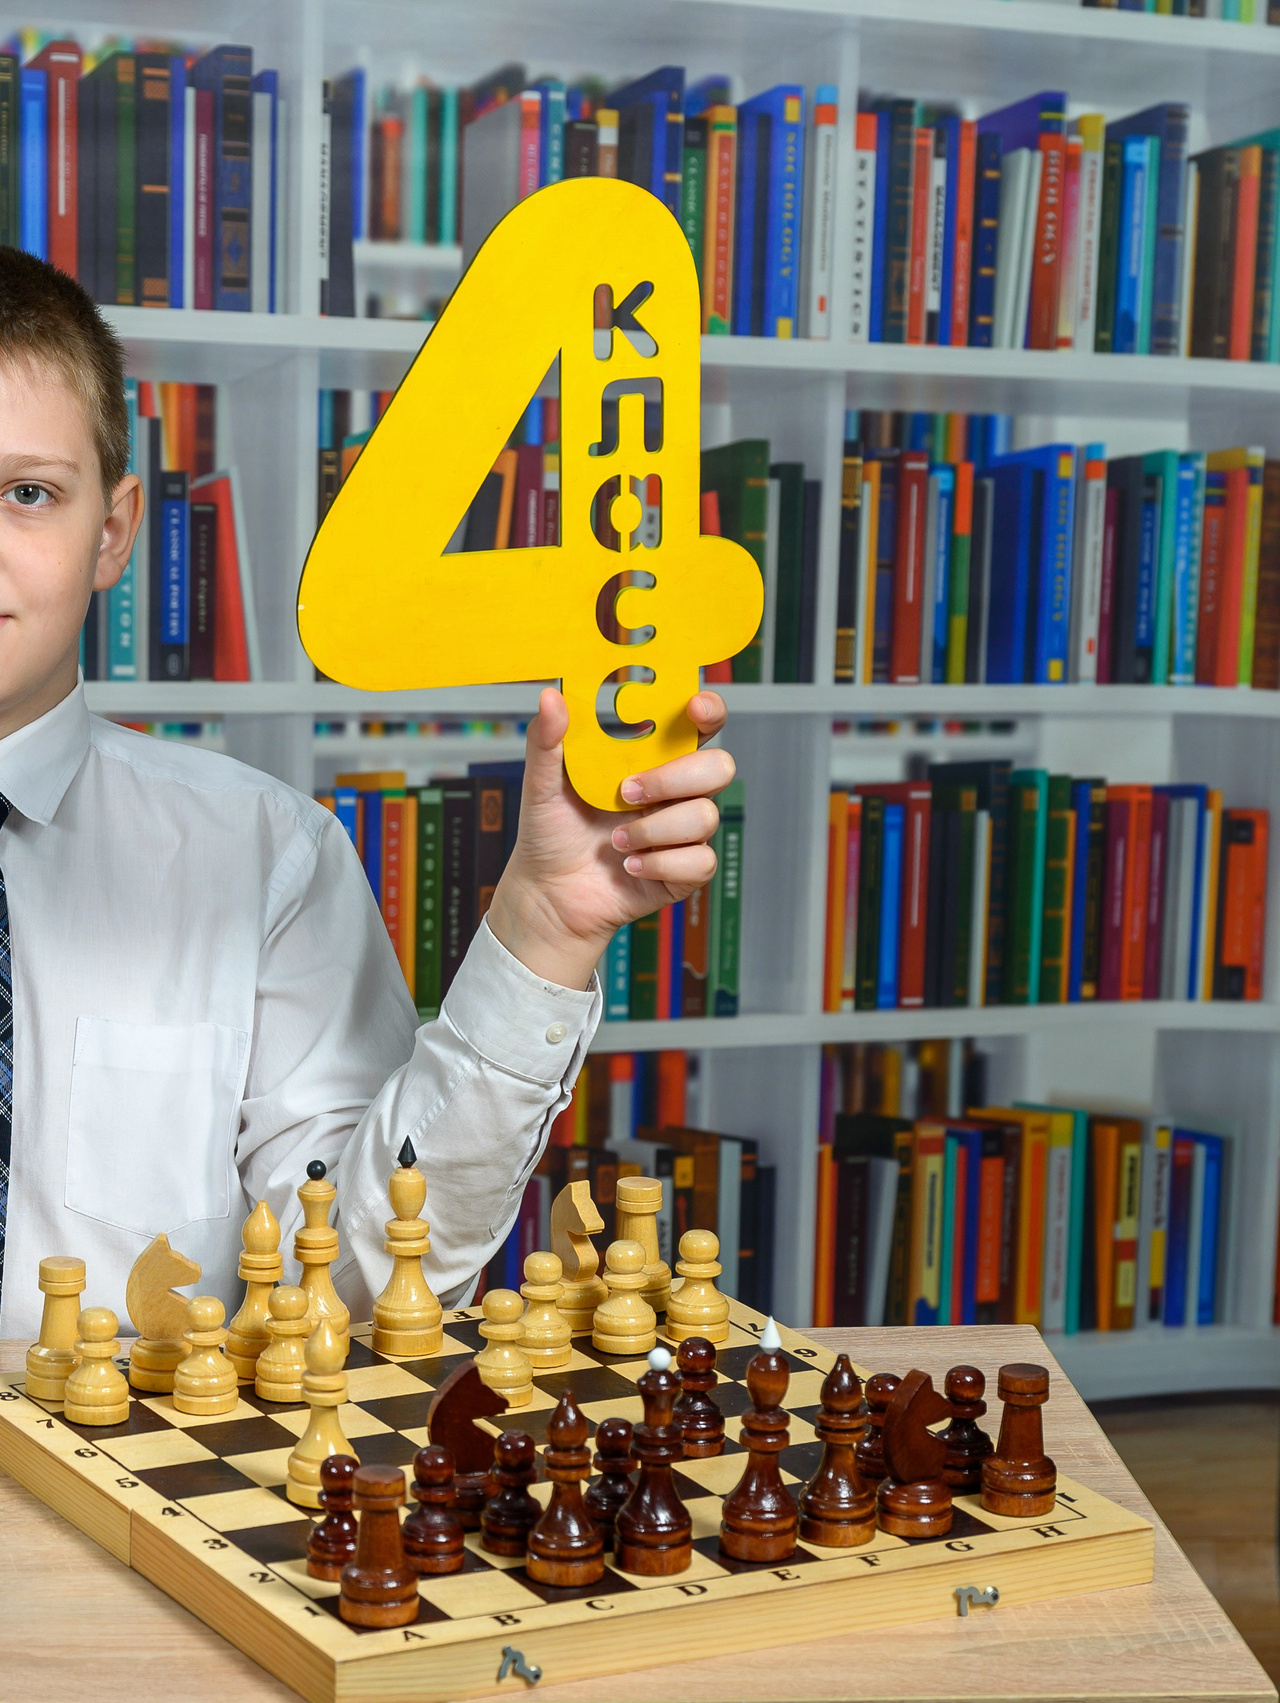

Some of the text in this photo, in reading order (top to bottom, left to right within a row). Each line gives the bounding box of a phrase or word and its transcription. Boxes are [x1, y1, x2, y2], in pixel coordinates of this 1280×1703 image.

[318, 142, 329, 259] MANAGEMENT
[780, 131, 797, 280] SOCIOLOGY
[851, 157, 869, 336] STATISTICS
[931, 184, 944, 293] MANAGEMENT
[298, 178, 764, 811] 4
[422, 822, 436, 952] BIOLOGY
[449, 816, 462, 958] Linear Algebra
[725, 832, 739, 899] HISTORY
[36, 1419, 54, 1428] 7
[75, 1449, 98, 1457] 6
[116, 1478, 139, 1488] 5
[162, 1507, 184, 1517] 4
[204, 1539, 228, 1549] 3
[250, 1572, 275, 1583] 2
[304, 1606, 320, 1616] 1
[403, 1524, 1067, 1642] A B C D E F G H
